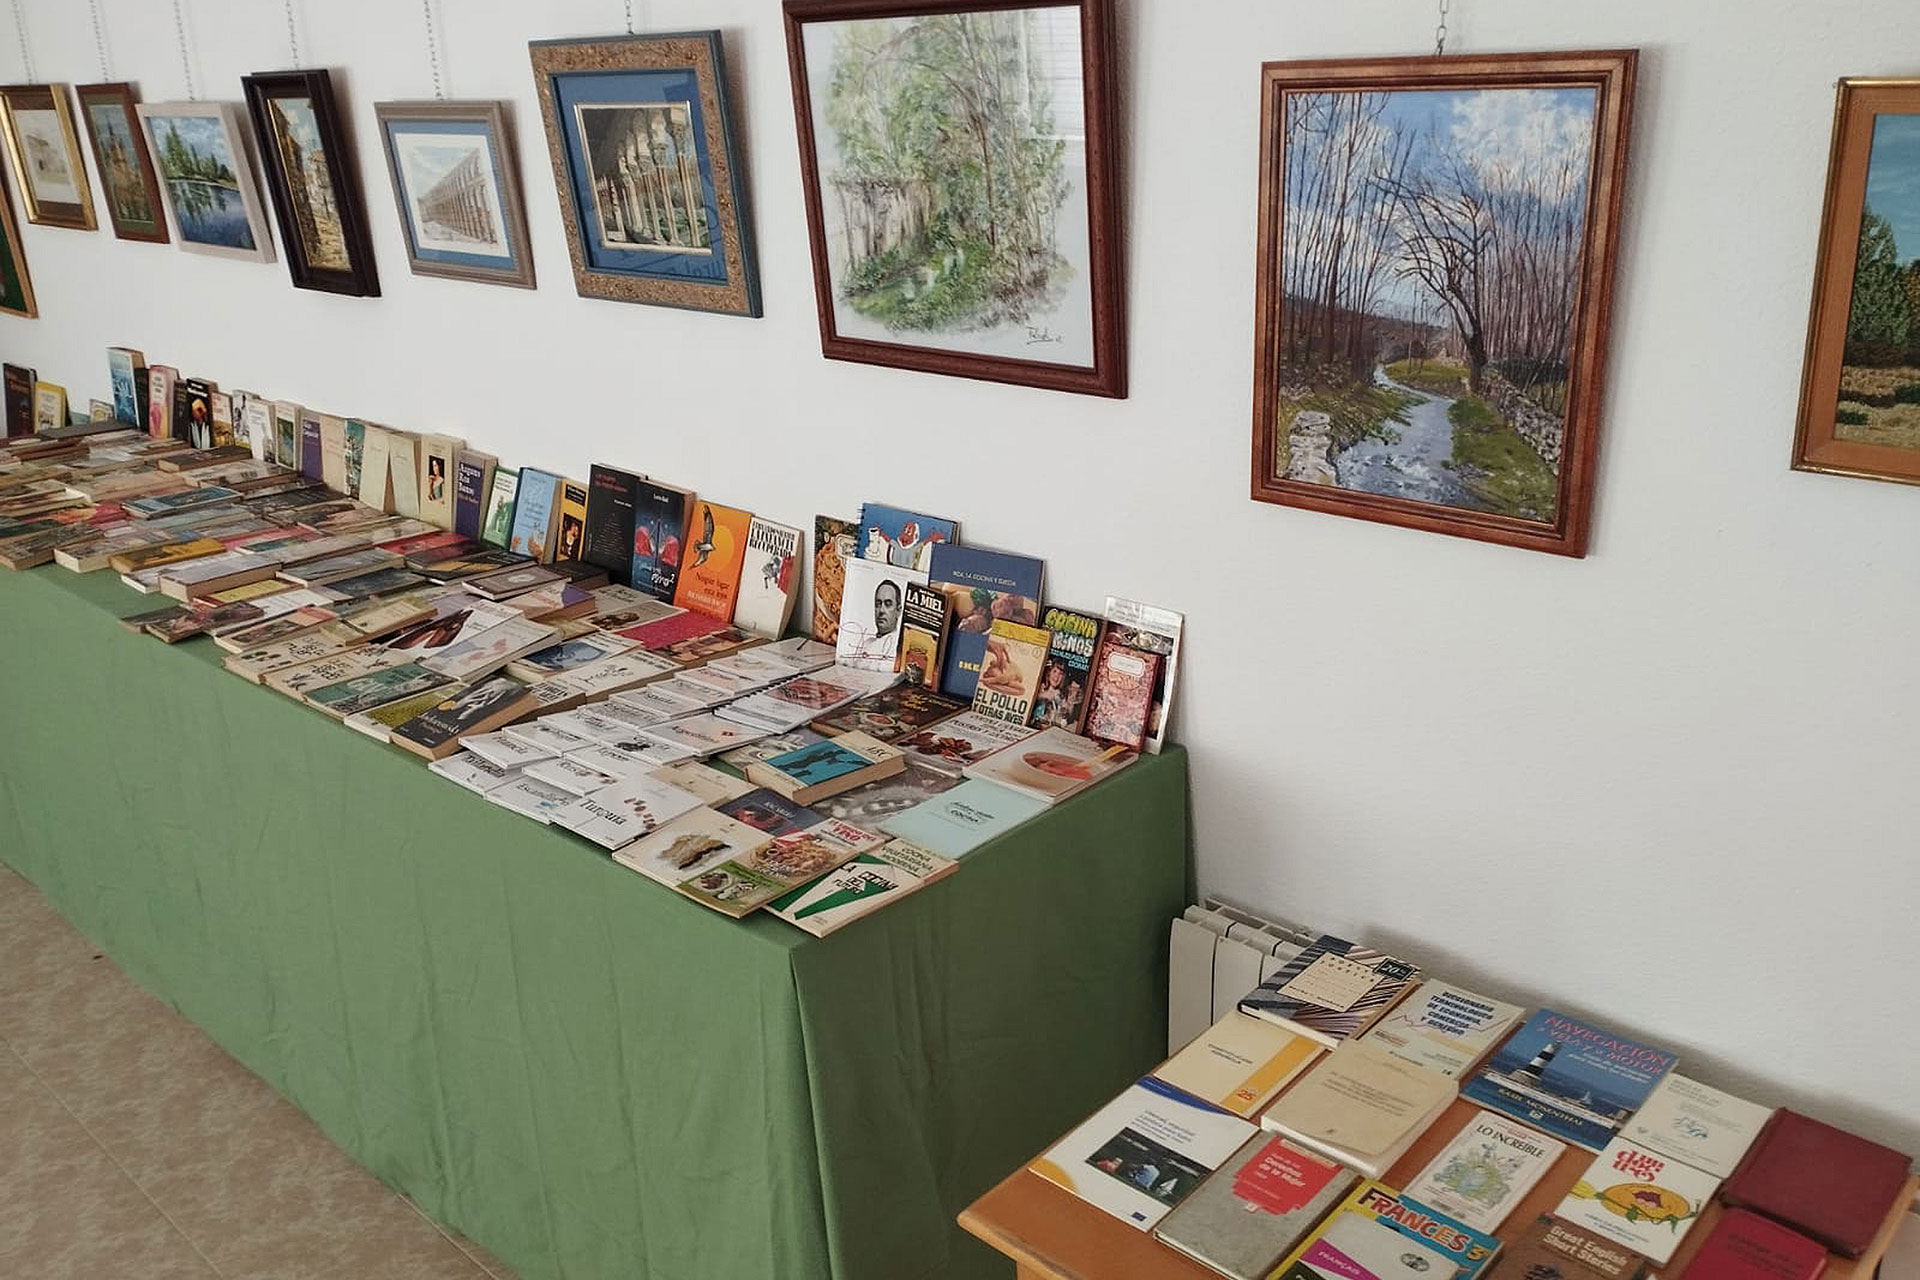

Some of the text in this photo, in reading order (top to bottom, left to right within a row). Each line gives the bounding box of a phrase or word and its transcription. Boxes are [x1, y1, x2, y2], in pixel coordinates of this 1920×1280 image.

[907, 589, 919, 604] LA
[920, 594, 943, 612] MIEL
[1045, 609, 1097, 639] COCINA
[973, 702, 980, 712] Y
[980, 704, 1003, 719] OTRAS
[975, 687, 988, 704] EL
[989, 692, 1028, 715] POLLO
[841, 863, 899, 893] LA COCINA
[846, 877, 864, 888] DEL
[1426, 1002, 1438, 1012] DE
[1442, 991, 1495, 1012] DICCIONARIO
[1545, 1015, 1670, 1067] NAVEGACIÓN
[1476, 1124, 1493, 1137] LO
[1357, 1186, 1470, 1253] FRANCES
[1543, 1233, 1622, 1276] Short Stories
[1550, 1225, 1584, 1247] Great
[1585, 1240, 1628, 1268] English
